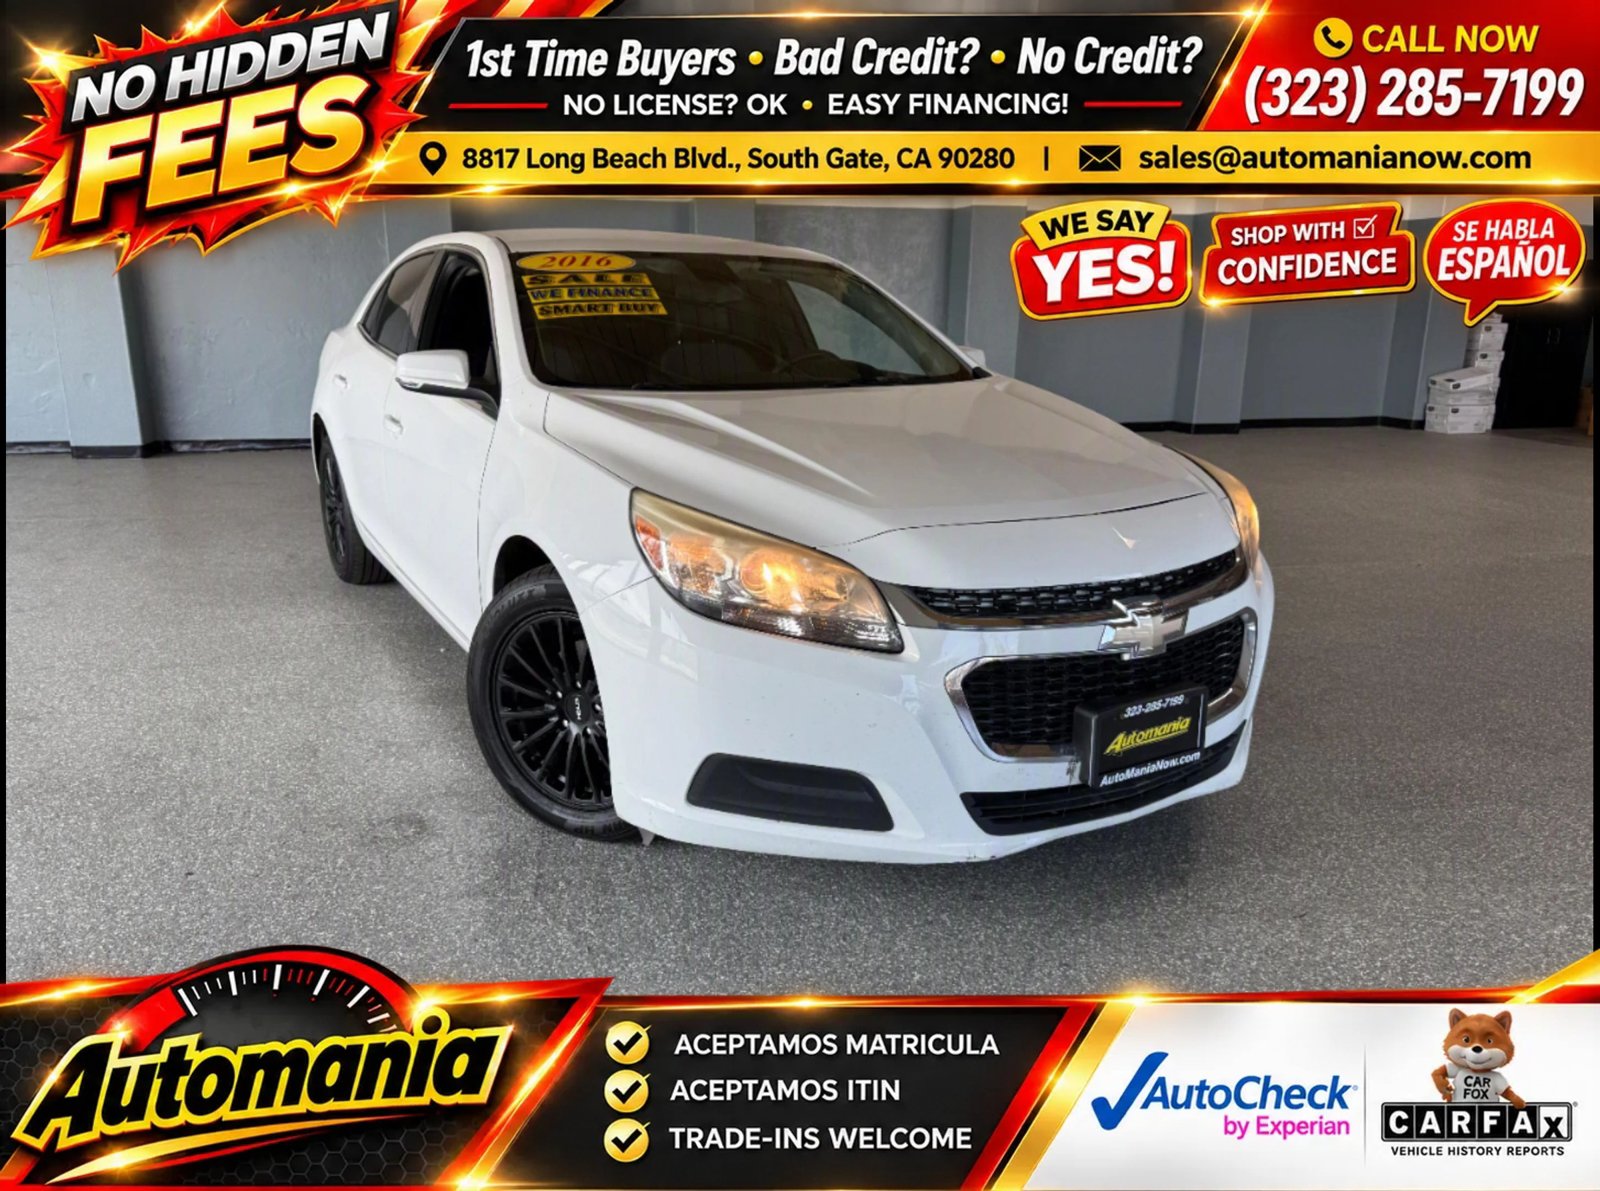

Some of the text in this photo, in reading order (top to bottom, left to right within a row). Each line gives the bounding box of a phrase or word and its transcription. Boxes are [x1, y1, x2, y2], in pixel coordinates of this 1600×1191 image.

[540, 256, 612, 268] 2016
[528, 274, 645, 285] SALE
[531, 286, 654, 300] WE FINANCE
[538, 303, 660, 316] SMART BUY
[1123, 694, 1185, 718] 323-285-7199
[1104, 716, 1191, 755] Automania
[1100, 751, 1201, 788] AutoManiaNow.com
